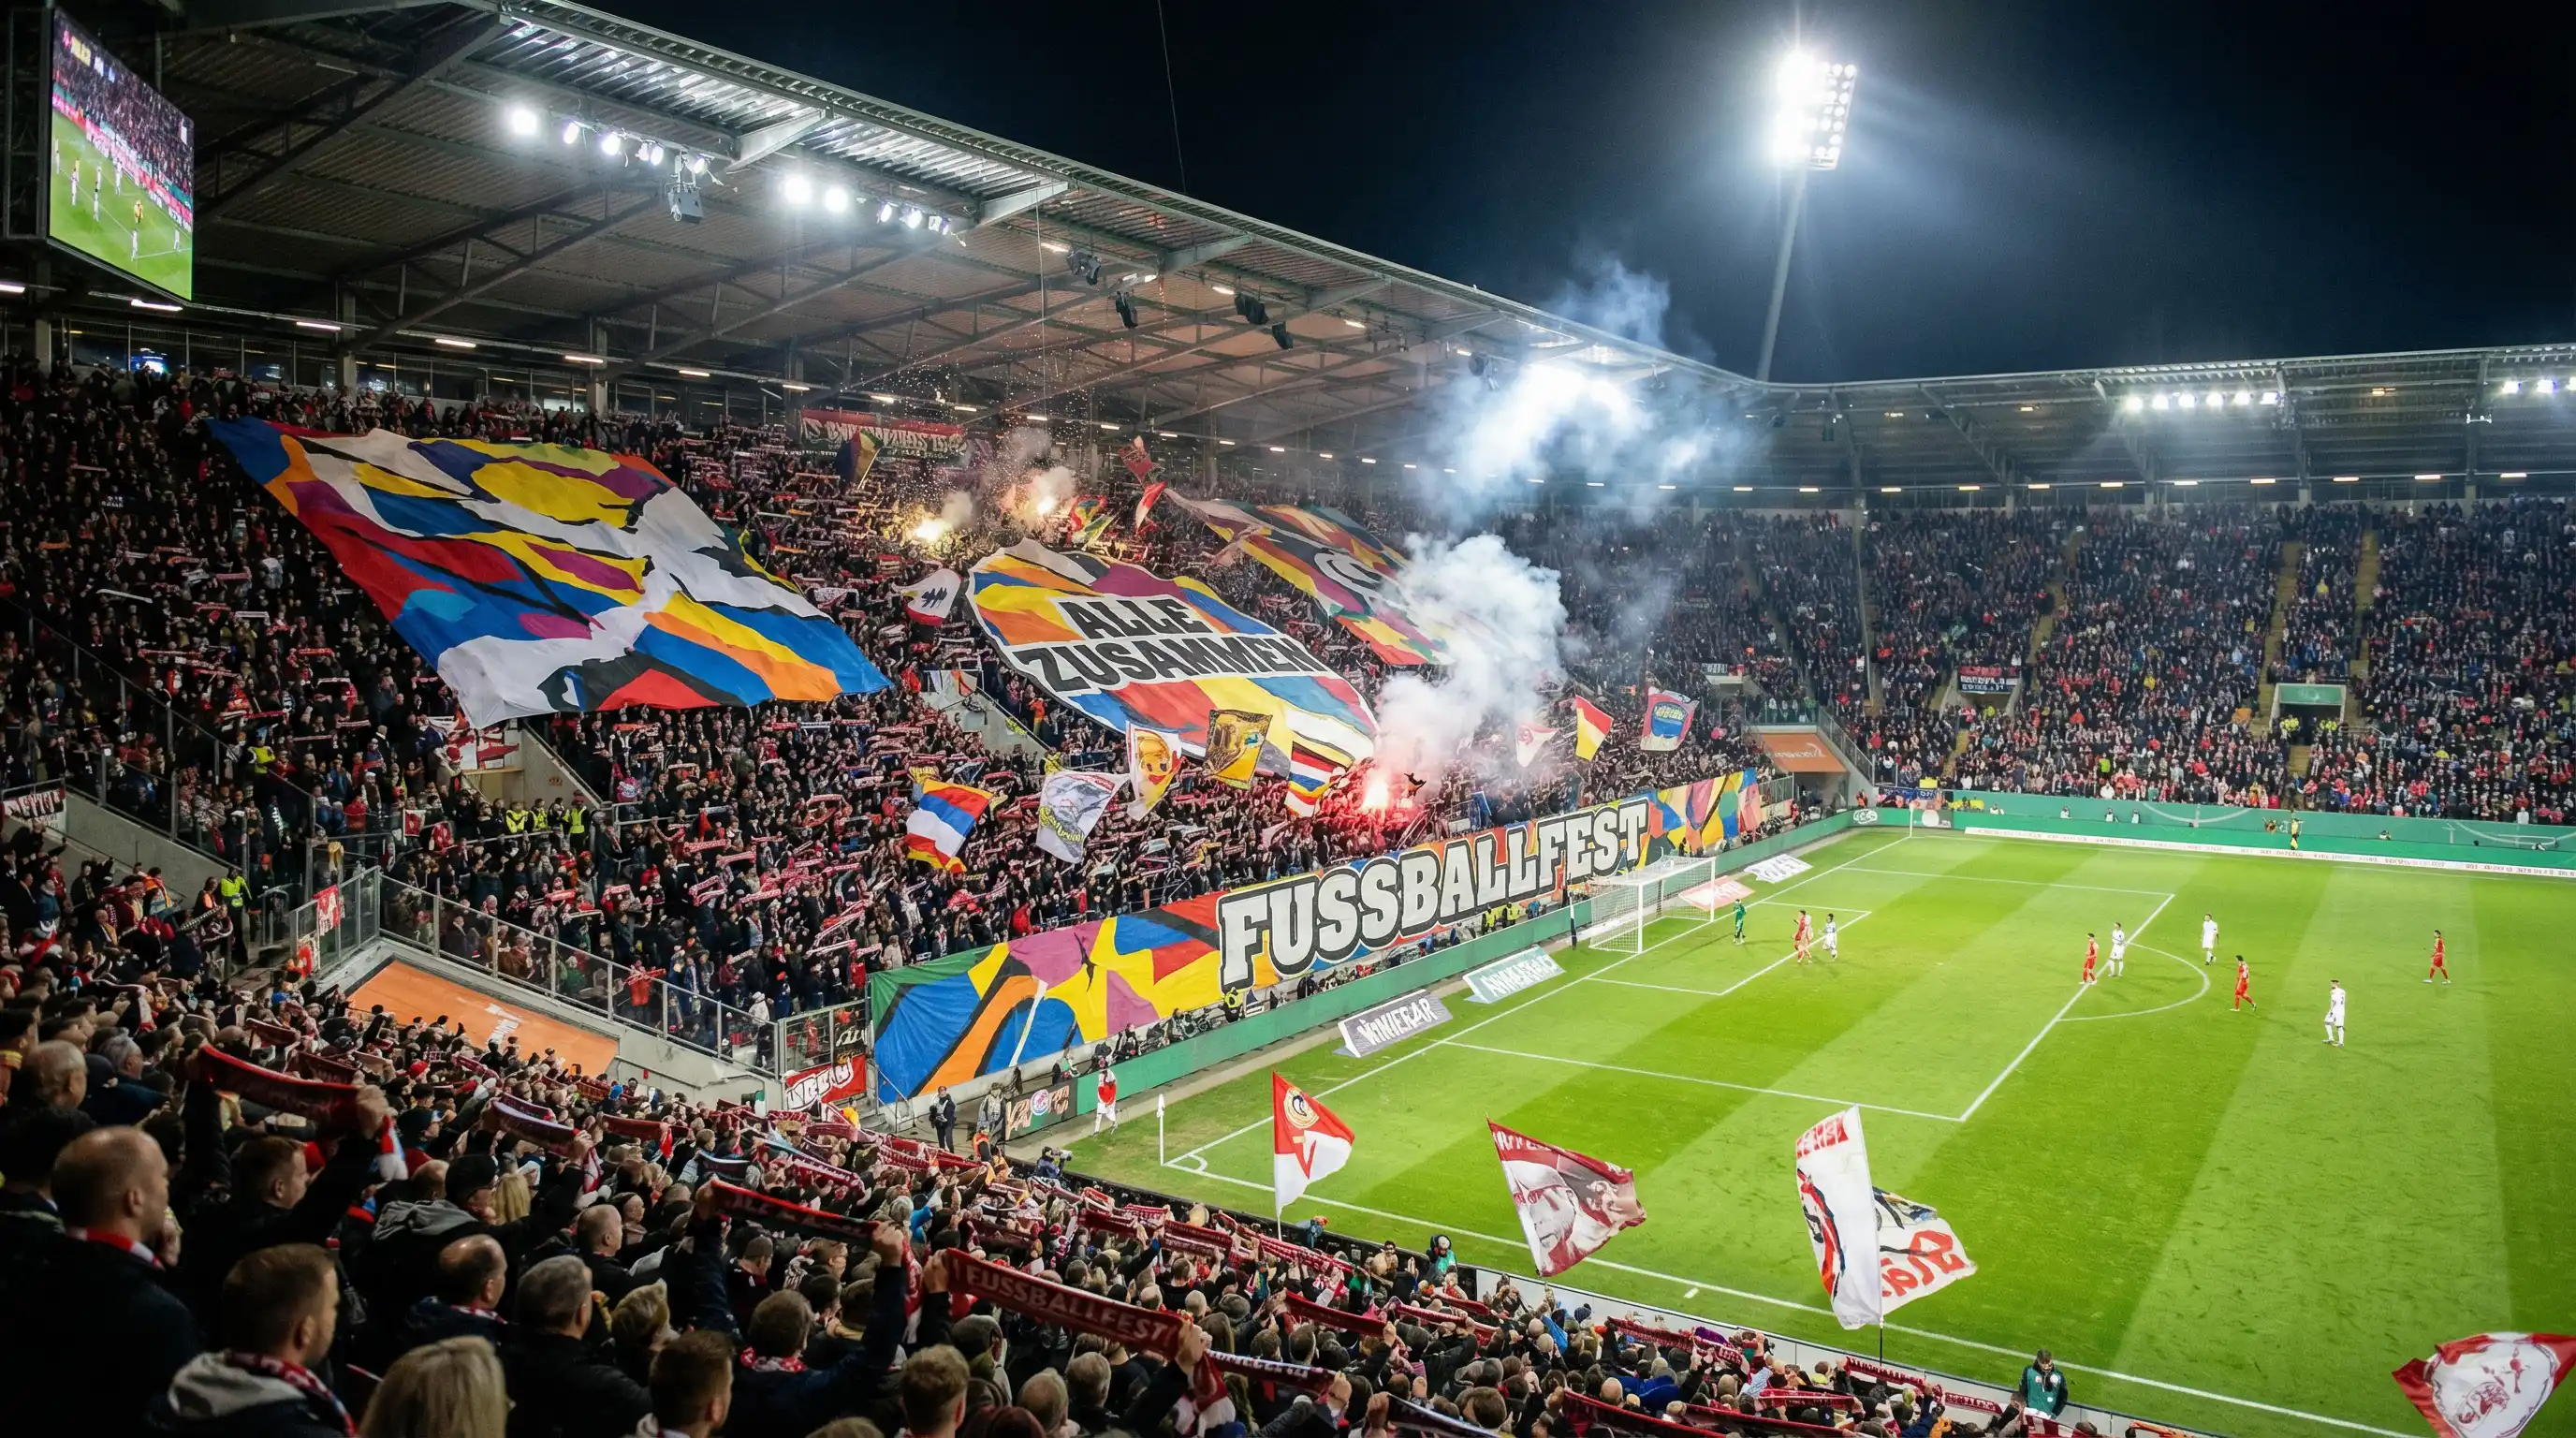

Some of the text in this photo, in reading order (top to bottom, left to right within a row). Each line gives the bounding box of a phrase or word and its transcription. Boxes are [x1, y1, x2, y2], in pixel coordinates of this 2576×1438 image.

[1061, 598, 1207, 638] ALLE
[1013, 637, 1328, 693] ZUSAMMEN
[1219, 800, 1648, 993] FUSSBALLFEST
